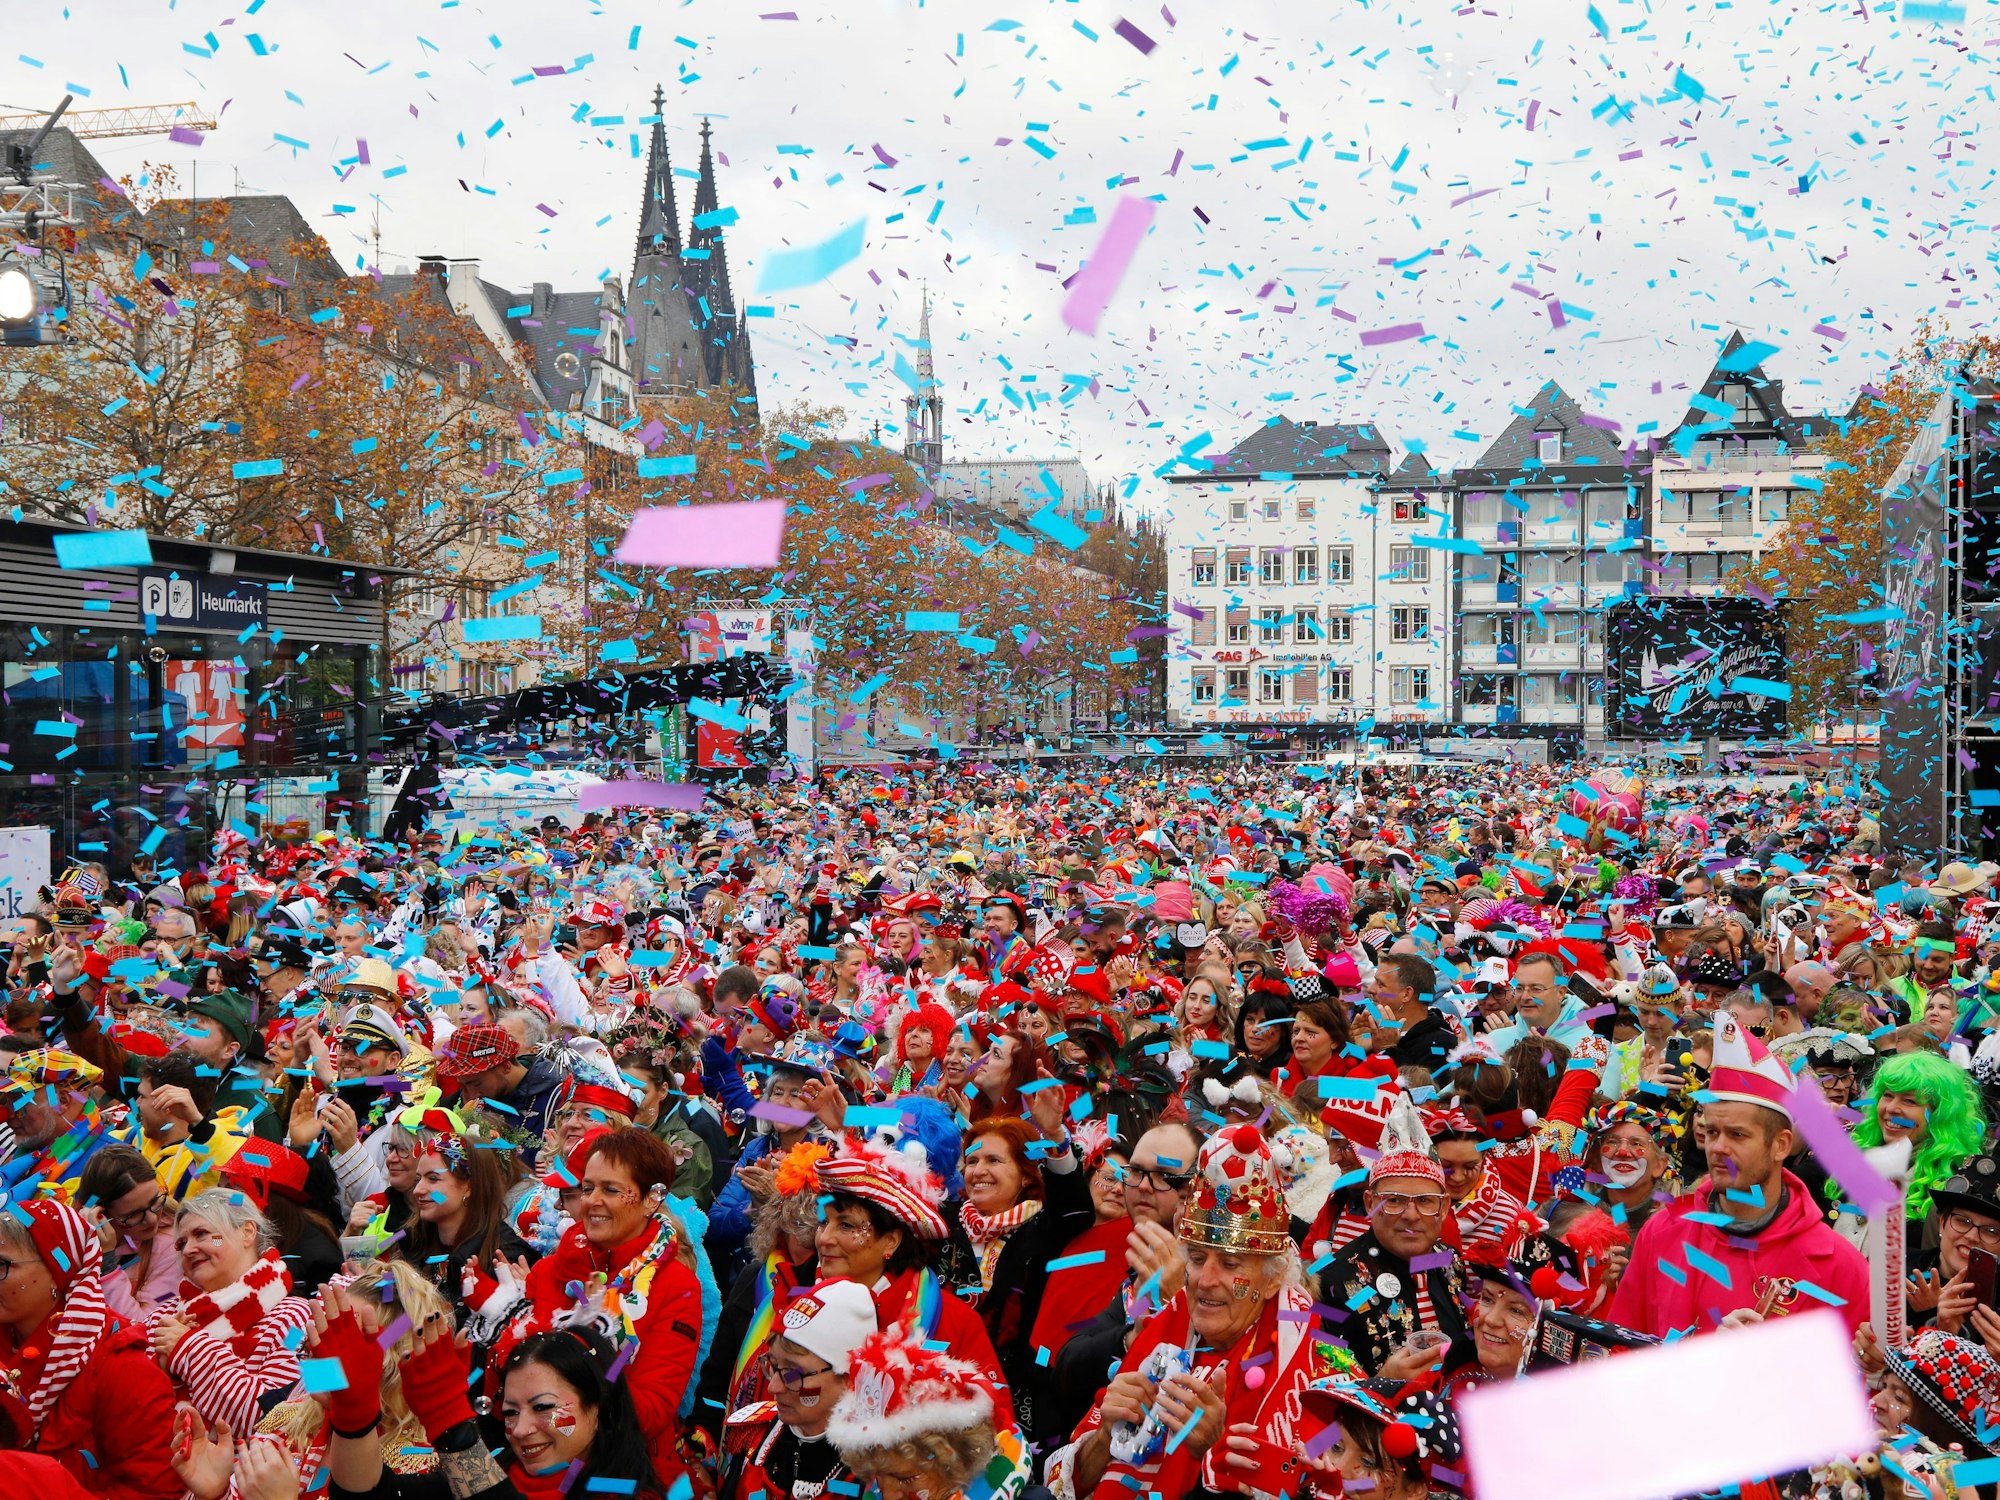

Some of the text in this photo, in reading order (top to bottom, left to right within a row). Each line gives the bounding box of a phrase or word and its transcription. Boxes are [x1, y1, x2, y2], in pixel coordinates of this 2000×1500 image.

[201, 592, 263, 615] Heumarkt
[731, 621, 754, 630] WDR
[1214, 651, 1243, 663] GAG
[1320, 654, 1333, 662] AG
[1391, 713, 1429, 723] HOTEL
[735, 827, 753, 838] uper
